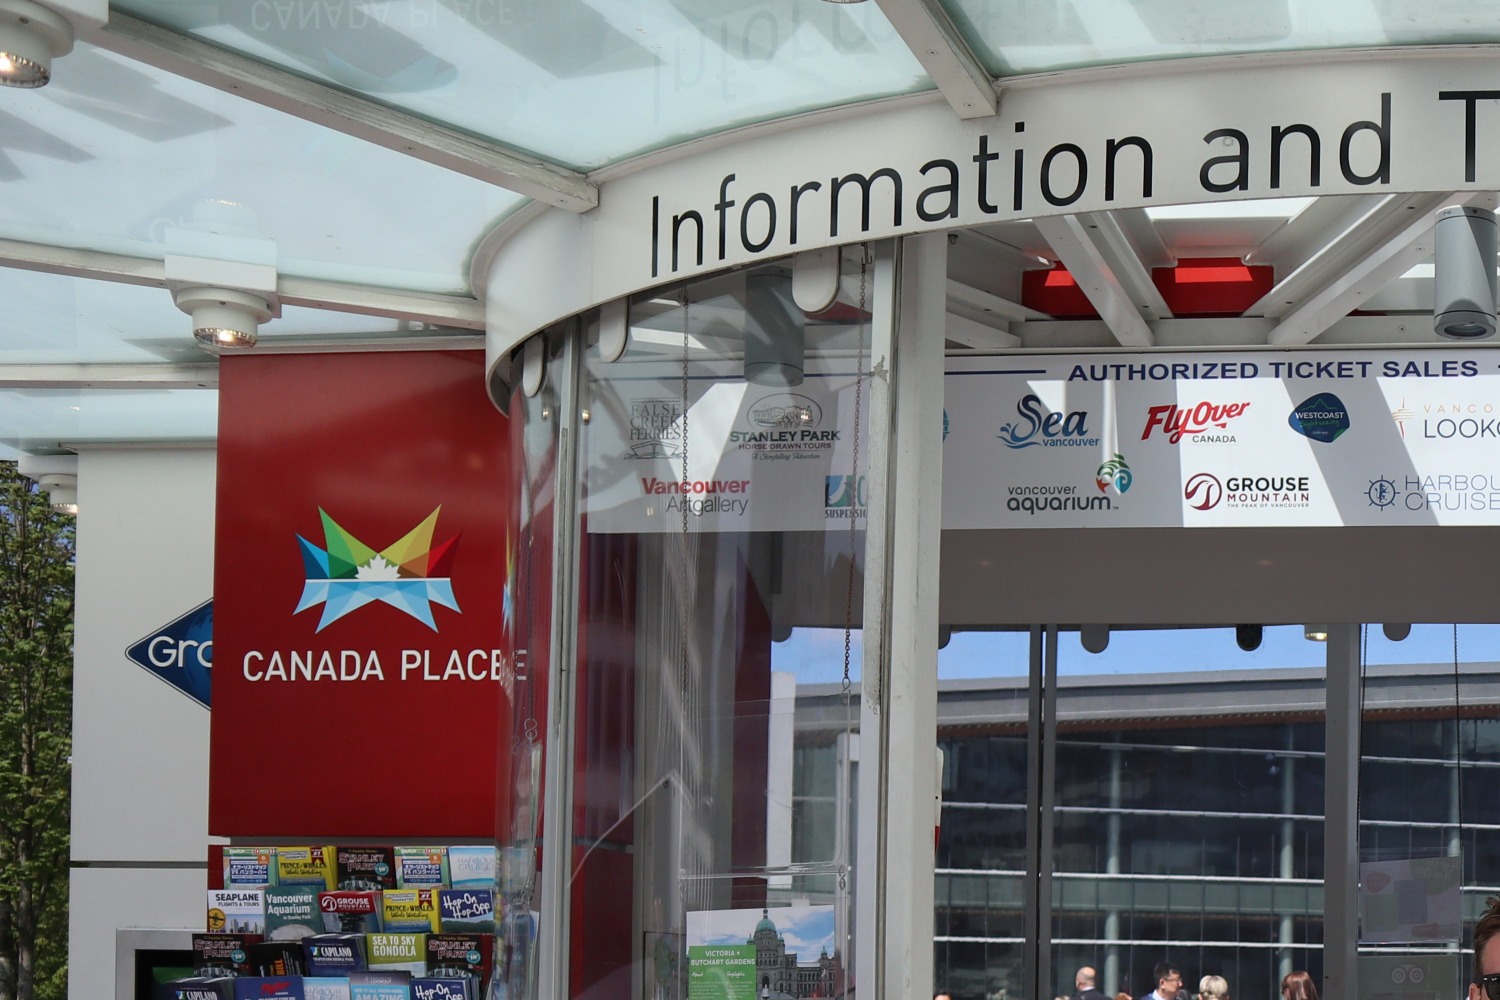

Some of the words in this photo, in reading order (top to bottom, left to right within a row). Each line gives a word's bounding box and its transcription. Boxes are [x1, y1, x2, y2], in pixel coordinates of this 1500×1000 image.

[651, 121, 1154, 279] Information
[1200, 92, 1392, 194] and
[1068, 362, 1258, 382] AUTHORIZED
[1268, 361, 1373, 379] TICKET
[1383, 360, 1479, 378] SALES
[631, 404, 681, 415] FALSE
[1295, 411, 1345, 419] WESTCOAST
[630, 416, 681, 428] CREEK
[1009, 394, 1089, 439] Sea
[1141, 401, 1251, 445] FlyOver
[629, 428, 681, 441] FERRIES
[729, 430, 797, 442] STANLEY
[800, 430, 841, 441] PARK
[1192, 434, 1237, 444] CANADA
[1042, 437, 1100, 448] vancouver
[641, 477, 750, 495] Vancouver
[1007, 486, 1077, 495] vancouver
[1226, 477, 1310, 492] GROUSE
[1227, 493, 1310, 502] MOUNTAIN
[666, 495, 749, 517] Artgallery
[1007, 496, 1111, 515] aquarium
[242, 649, 385, 682] CANADA
[338, 853, 385, 863] STANLEY
[215, 894, 259, 902] SEAPLANE
[266, 894, 313, 904] Vancouver
[443, 892, 477, 911] Hop-On
[267, 904, 310, 917] Aquarium
[452, 902, 491, 919] Hop-Off
[194, 939, 242, 950] STANLEY
[372, 936, 388, 946] SEA
[389, 936, 399, 945] TO
[401, 936, 416, 945] SKY
[428, 940, 477, 951] STANLEY
[320, 947, 352, 957] CAPILANO
[373, 945, 417, 957] GONDOLA
[725, 958, 755, 966] GARDENS
[186, 991, 218, 1000] CAPILANO
[415, 983, 450, 1000] Hop-On
